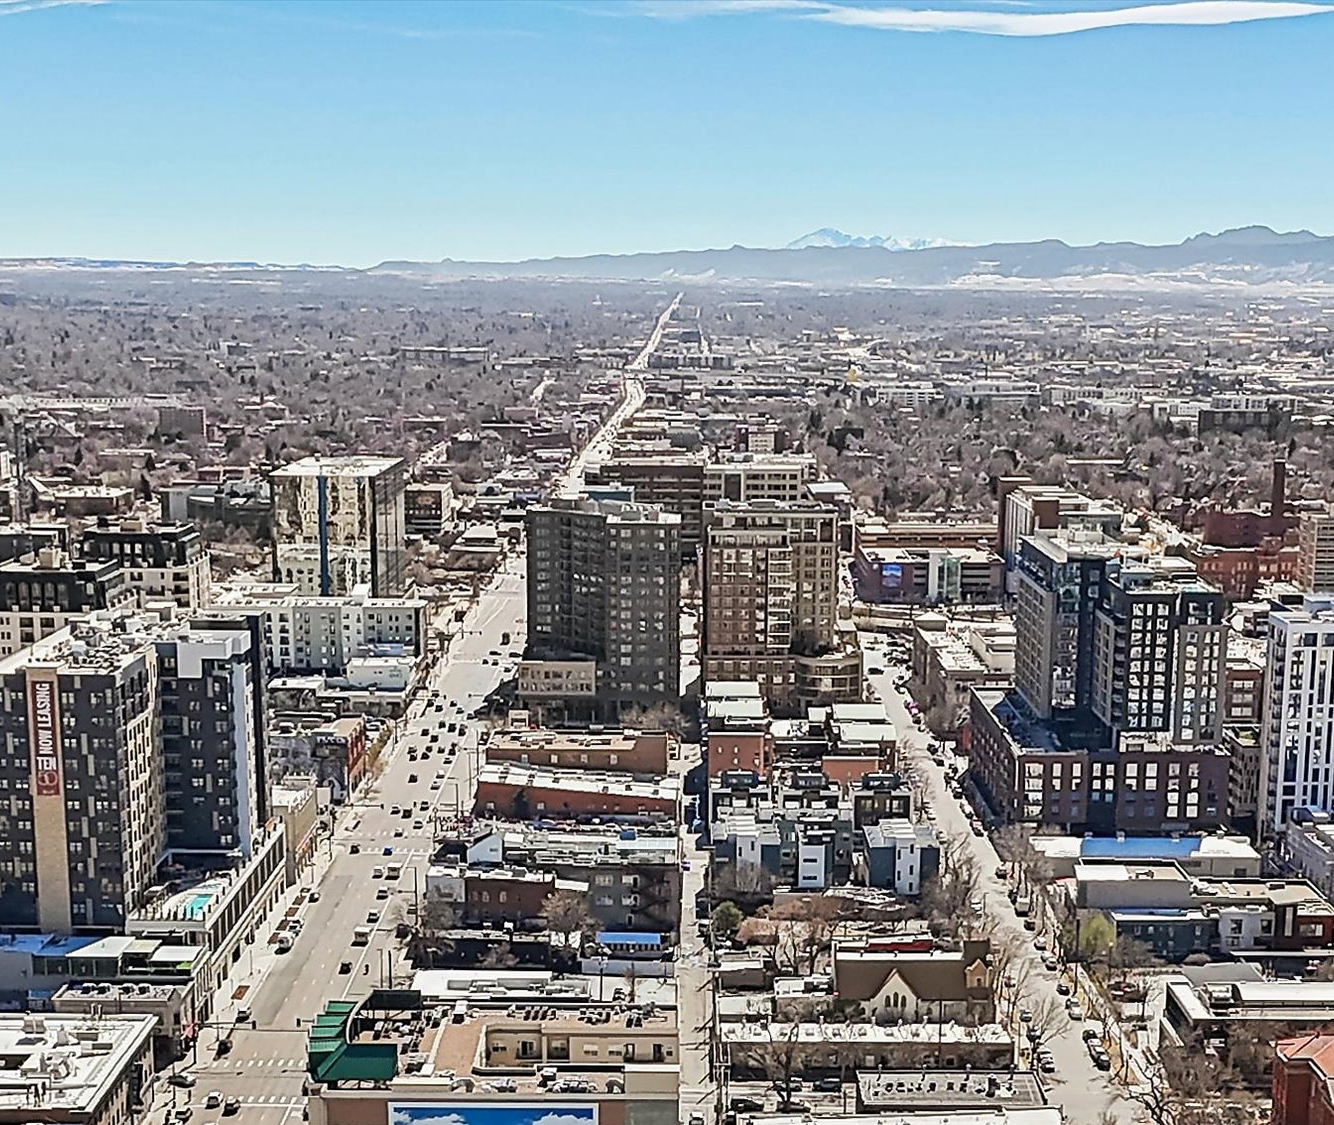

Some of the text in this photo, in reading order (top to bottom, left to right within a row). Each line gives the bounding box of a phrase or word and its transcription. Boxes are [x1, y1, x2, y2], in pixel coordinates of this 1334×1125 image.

[36, 683, 53, 755] NOW LEASING
[36, 756, 57, 770] TEN
